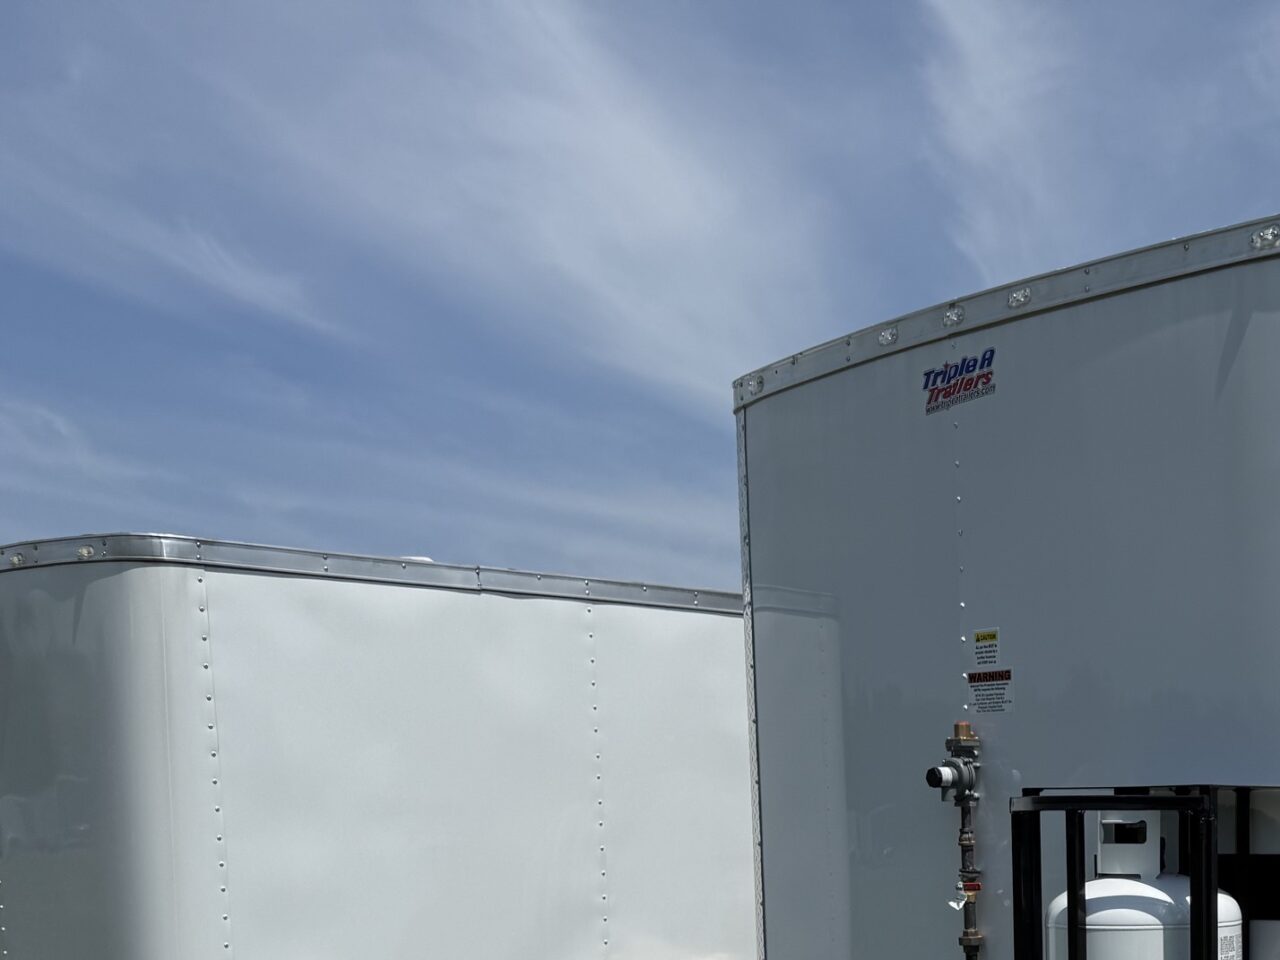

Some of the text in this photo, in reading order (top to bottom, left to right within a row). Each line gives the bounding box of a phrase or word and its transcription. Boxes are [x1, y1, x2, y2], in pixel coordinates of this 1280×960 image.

[924, 347, 995, 390] Triple A
[927, 371, 994, 406] Trailers
[969, 670, 1011, 683] WARNING
